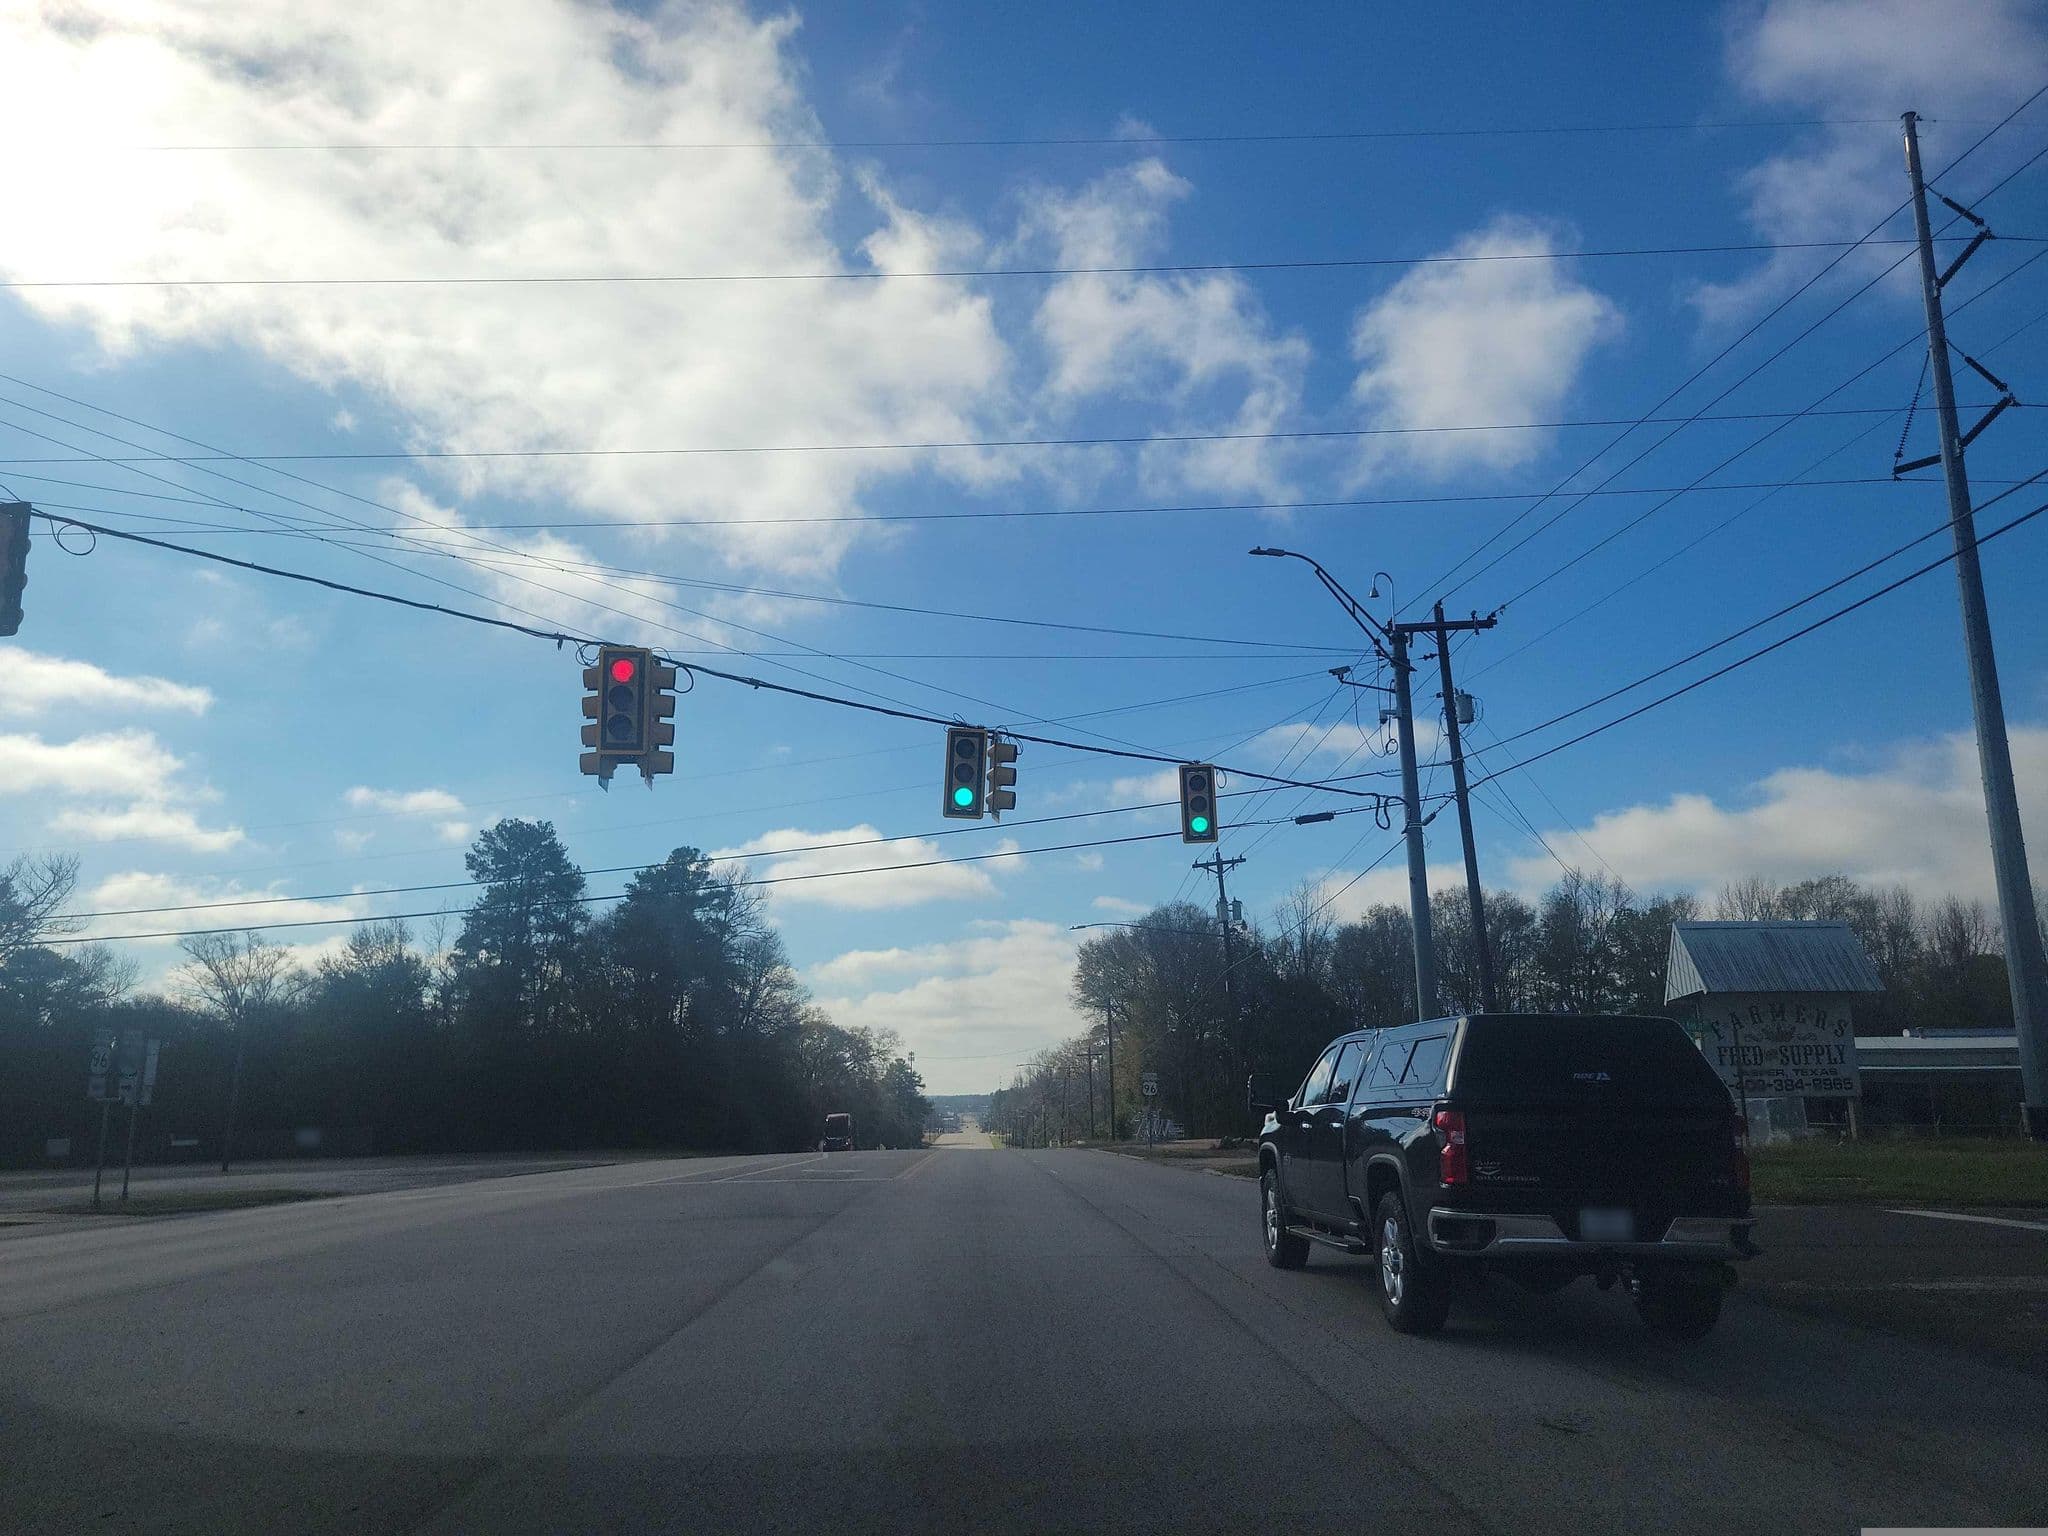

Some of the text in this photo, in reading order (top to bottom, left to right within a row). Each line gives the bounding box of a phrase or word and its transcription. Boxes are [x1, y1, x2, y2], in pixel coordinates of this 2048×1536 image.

[1711, 1002, 1848, 1041] FARMERS
[1717, 1045, 1763, 1066] FEED
[1779, 1044, 1846, 1065] SUPPLY
[1792, 1068, 1838, 1076] TEXAS
[1144, 1084, 1156, 1093] 96
